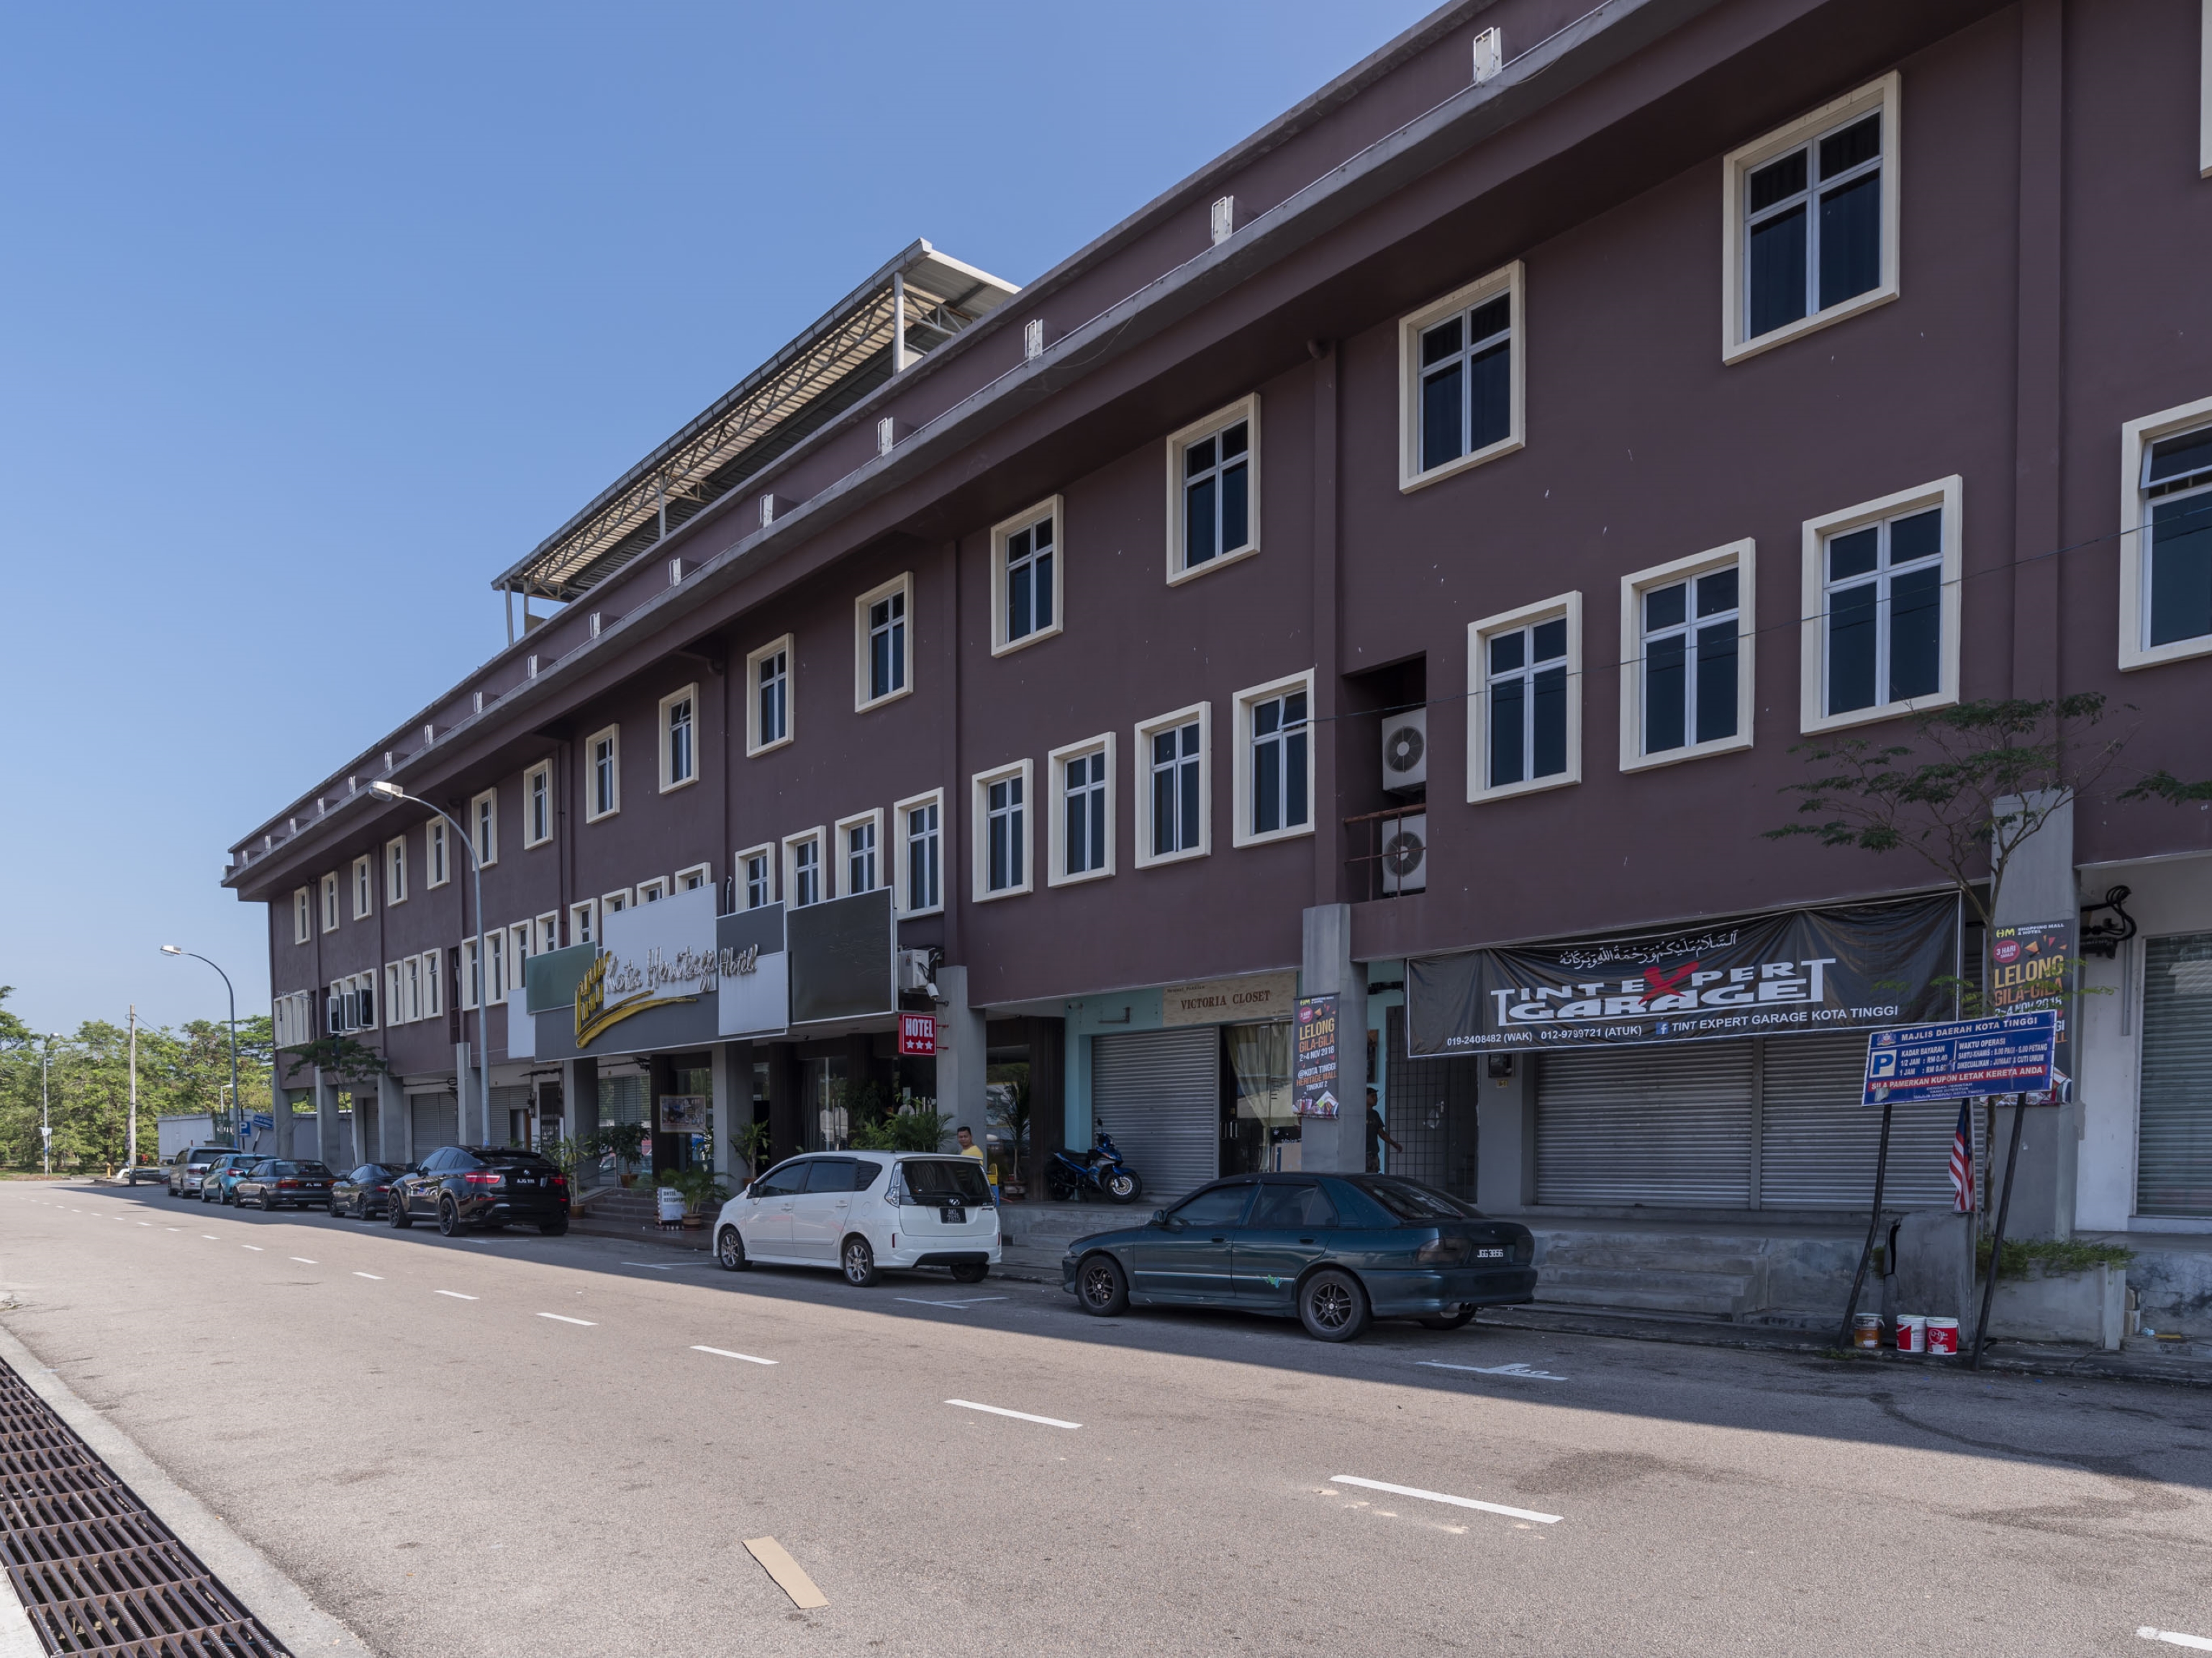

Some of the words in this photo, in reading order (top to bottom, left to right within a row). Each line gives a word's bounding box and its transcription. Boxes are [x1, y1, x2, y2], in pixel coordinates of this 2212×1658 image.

[2001, 945, 2016, 954] HARI
[604, 955, 643, 995] Kota
[718, 943, 758, 977] Hotel
[1995, 955, 2064, 989] LELONG
[1181, 995, 1226, 1010] VICTORIA
[1233, 990, 1271, 1004] CLOSET
[1490, 982, 1605, 1027] TINT
[1621, 958, 1836, 1005] EXPERT
[1508, 978, 1808, 1020] GARAGE
[905, 1018, 933, 1038] HOTEL
[1672, 1020, 1697, 1032] TINT
[1700, 1015, 1749, 1029] EXPERT
[1751, 1012, 1808, 1025] GARAGE
[1811, 1009, 1847, 1021] KOTA
[1850, 1005, 1898, 1018] TINGGI
[1300, 1018, 1335, 1041] LELONG
[1447, 1033, 1502, 1046] 019-2408482
[1503, 1031, 1533, 1043] (WAK)
[1541, 1028, 1602, 1040] 012-9799721
[1605, 1025, 1642, 1038] (ATUK)
[1901, 1030, 1933, 1041] MAJLIS
[1936, 1025, 1972, 1036] DAERAH
[1975, 1022, 2000, 1031] KOTA
[2003, 1017, 2037, 1028] TINGGI
[1299, 1033, 1335, 1053] GILA-GILA
[1310, 1048, 1320, 1059] NOV
[1321, 1046, 1334, 1056] 2018
[1921, 1046, 1945, 1055] BAYARAN
[1958, 1049, 1990, 1059] SABTU-KHAMIS
[2029, 1043, 2047, 1052] PETANG
[1959, 1041, 1980, 1049] WAKTU
[1980, 1038, 2005, 1047] OPERASI
[1298, 1067, 1318, 1079] @KOTA
[1318, 1062, 1336, 1073] TINGGI
[1872, 1054, 1894, 1074] P
[1957, 1060, 1989, 1069] DIKECUALIKAN
[1297, 1074, 1322, 1086] HERITAGE
[1323, 1071, 1337, 1080] MALL
[1890, 1077, 1929, 1087] PAMERKAN
[1931, 1074, 1957, 1084] KUPON
[1959, 1072, 1984, 1081] LETAK
[1986, 1069, 2017, 1078] KERETA
